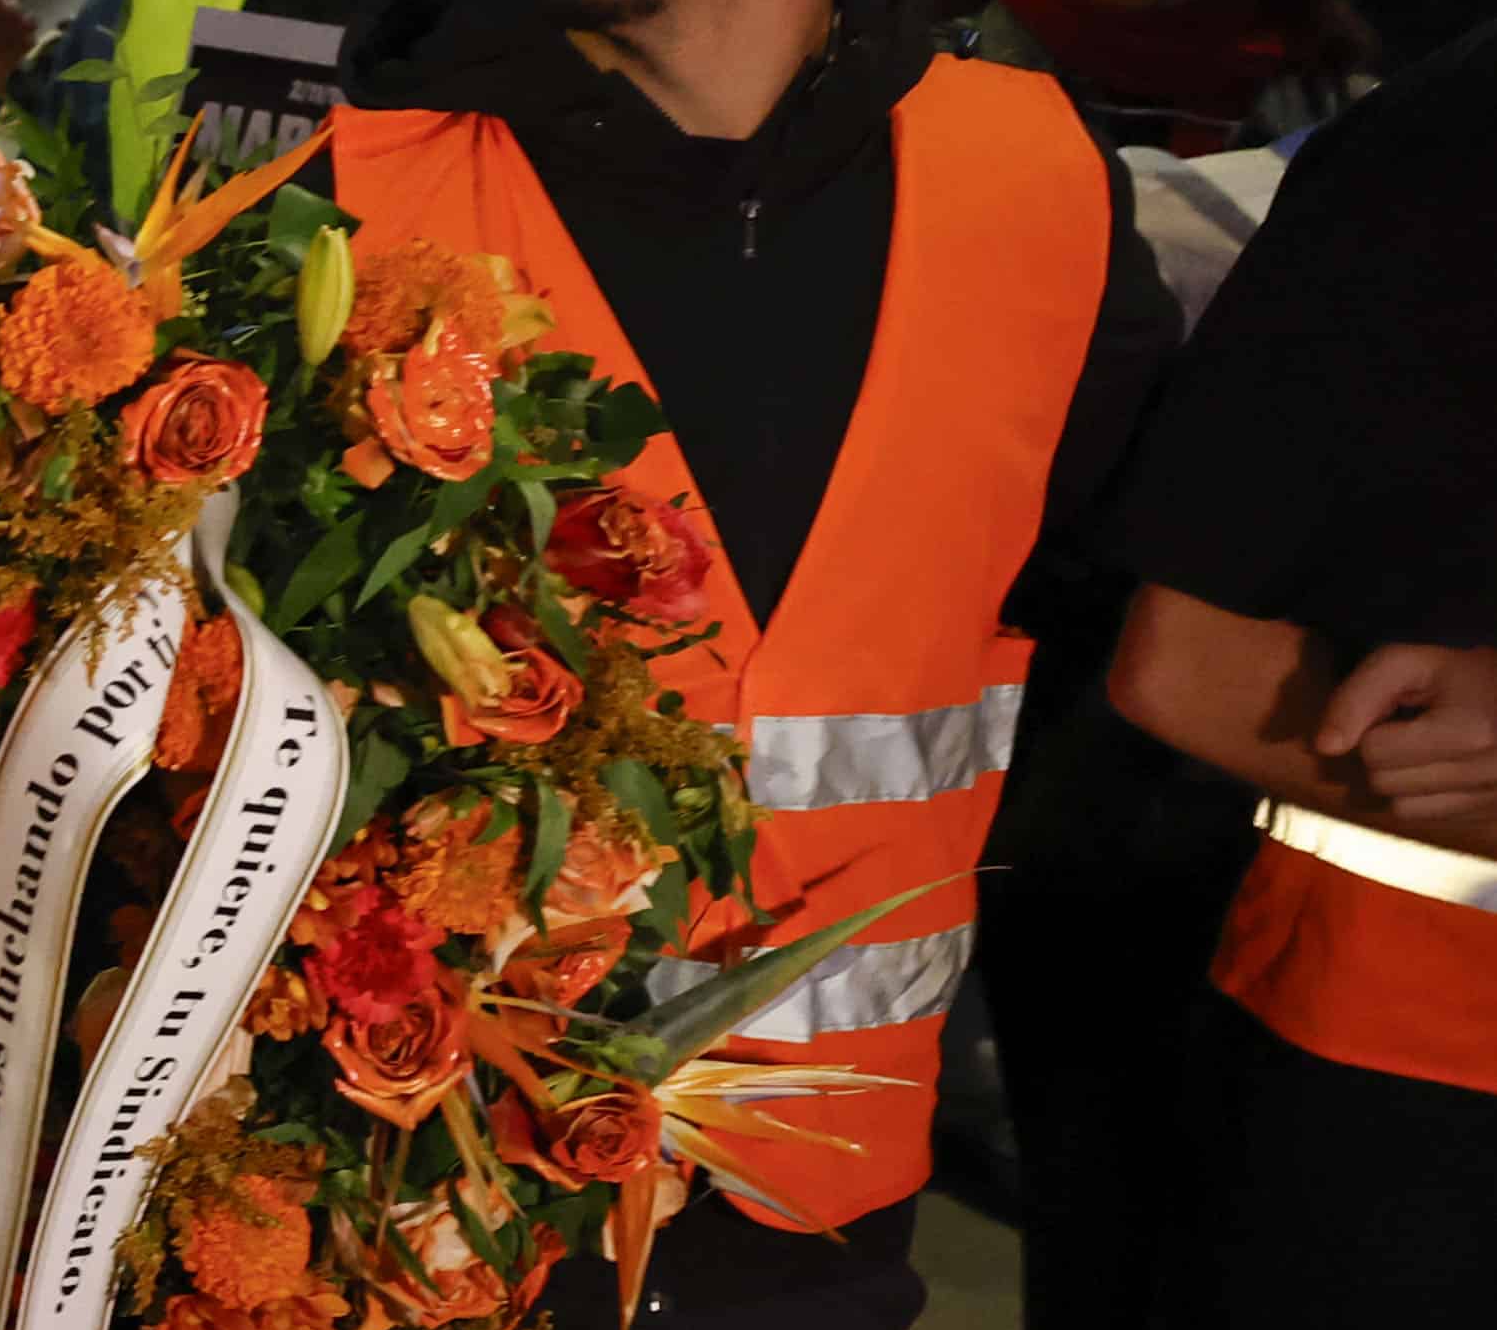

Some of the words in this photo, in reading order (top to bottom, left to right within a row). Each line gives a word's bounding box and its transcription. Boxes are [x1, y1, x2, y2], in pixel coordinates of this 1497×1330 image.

[192, 101, 316, 165] MAR
[74, 660, 152, 748] por
[277, 695, 317, 768] Te
[183, 787, 288, 968] quiere,
[157, 990, 205, 1037] tu
[56, 1056, 178, 1314] Sindicato.
